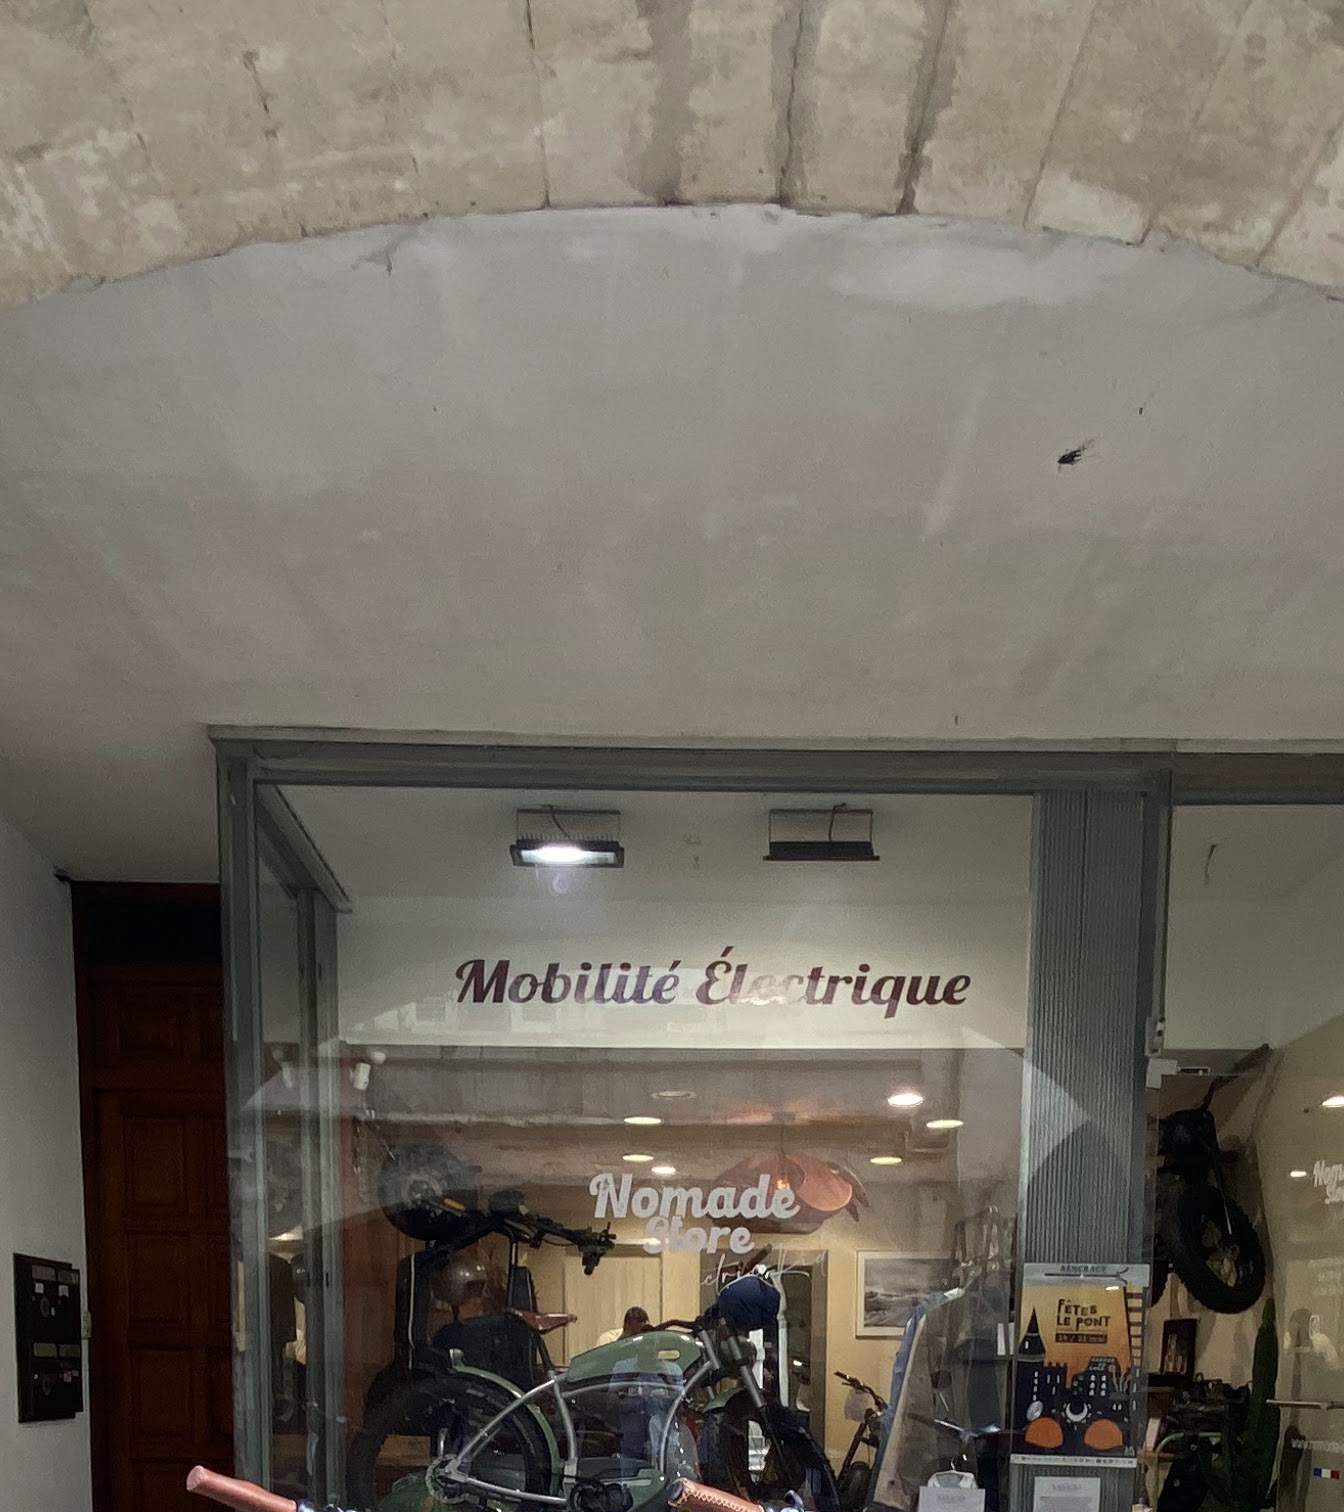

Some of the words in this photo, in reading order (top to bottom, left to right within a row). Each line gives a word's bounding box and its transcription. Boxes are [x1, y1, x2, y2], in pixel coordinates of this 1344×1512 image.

[455, 958, 680, 1004] Mobilité
[696, 946, 971, 1019] Électrique
[589, 1173, 801, 1220] Nomade
[642, 1214, 755, 1254] Store
[1057, 1315, 1071, 1327] LE
[1076, 1316, 1111, 1332] PONT
[1058, 1298, 1098, 1317] FÊTES
